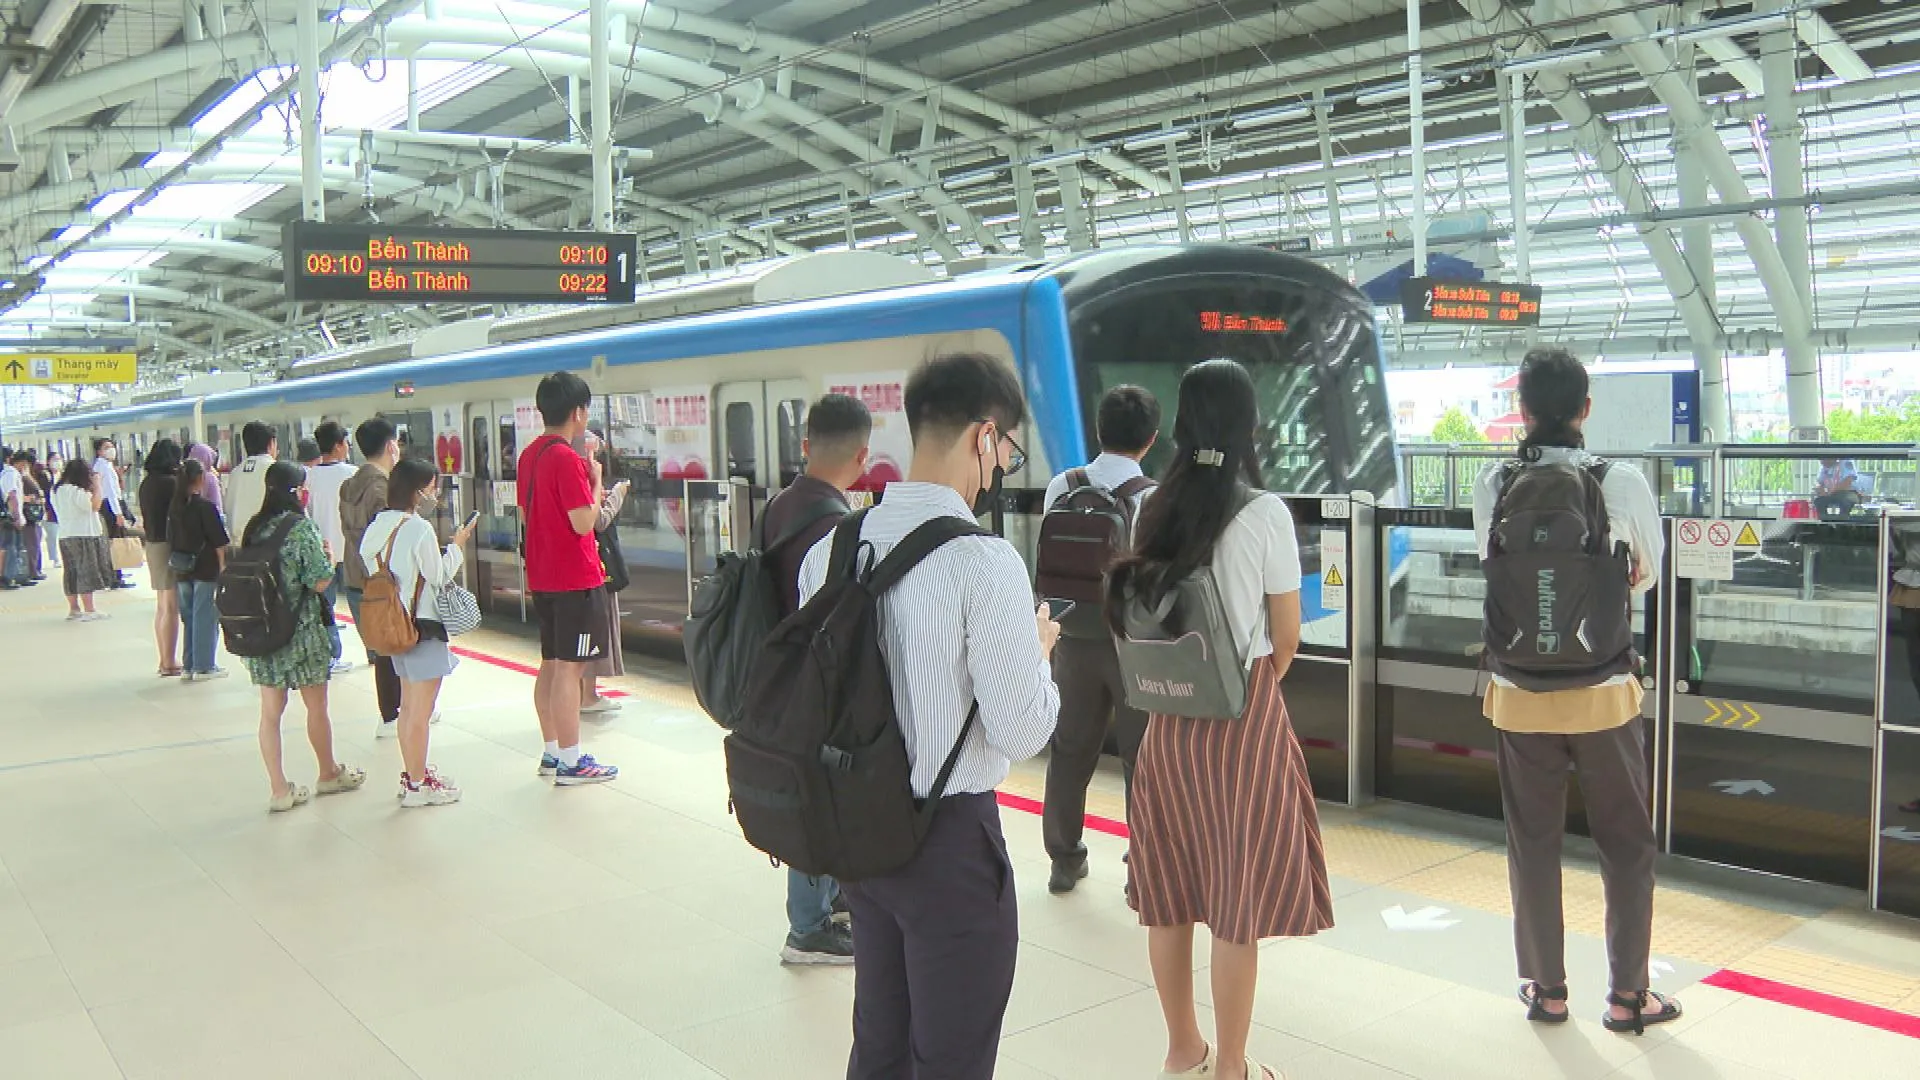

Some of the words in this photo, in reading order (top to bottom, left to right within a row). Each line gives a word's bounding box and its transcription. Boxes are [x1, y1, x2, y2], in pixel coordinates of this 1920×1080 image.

[368, 237, 407, 261] Bến
[412, 240, 469, 262] Thành
[559, 245, 608, 265] 09:10
[307, 254, 364, 274] 09:10
[617, 253, 627, 283] 1
[368, 267, 407, 291] Bến
[412, 270, 469, 292] Thành
[559, 274, 608, 294] 09:22
[1424, 289, 1433, 311] 2
[56, 358, 92, 370] Thang
[1324, 501, 1345, 517] 1-20
